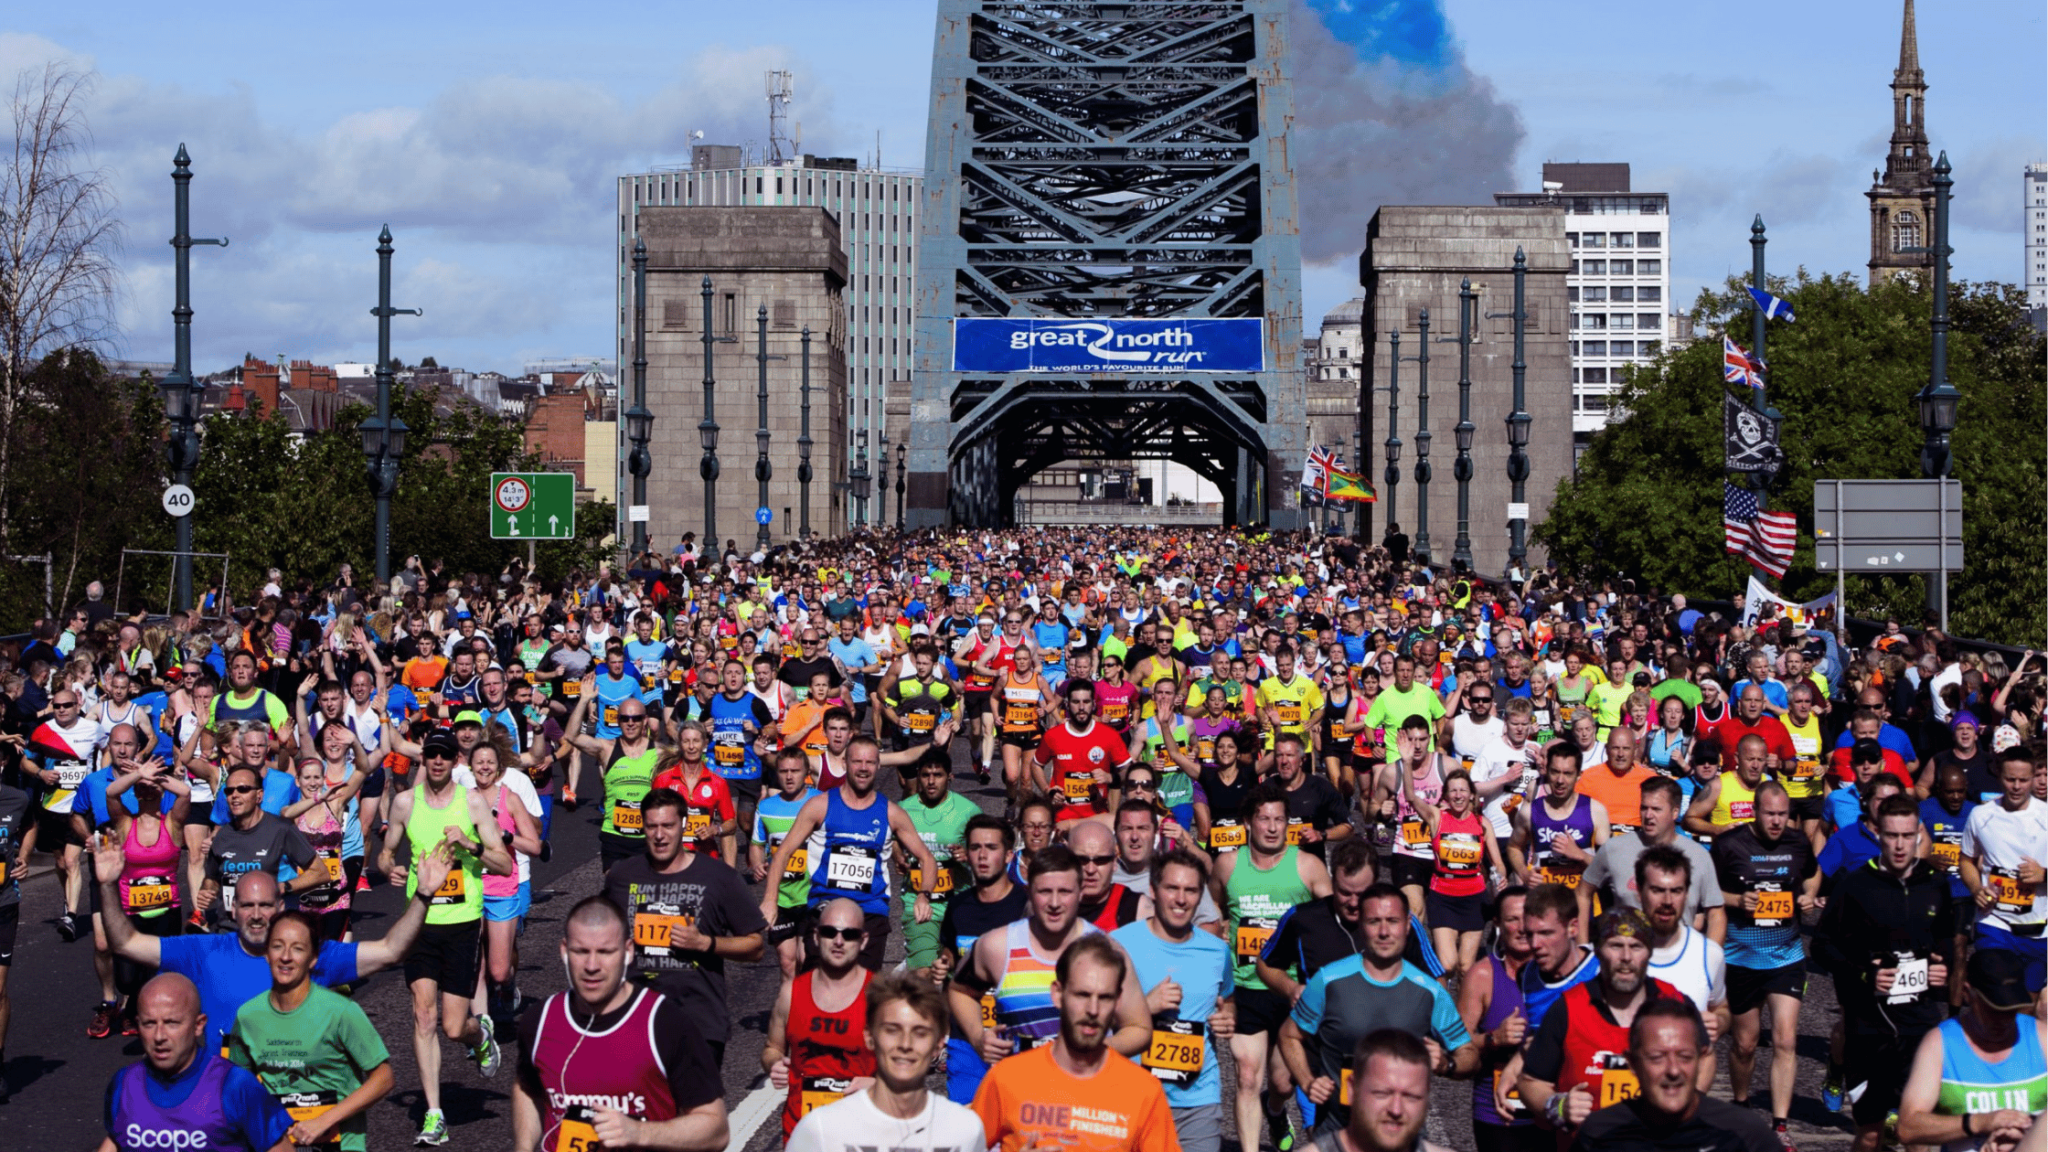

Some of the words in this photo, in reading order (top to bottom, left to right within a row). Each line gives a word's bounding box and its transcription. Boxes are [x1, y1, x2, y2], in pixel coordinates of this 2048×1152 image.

[1010, 330, 1087, 349] great
[1117, 328, 1193, 347] north
[1153, 351, 1202, 363] run
[1102, 364, 1160, 372] FAVOURITE
[502, 486, 516, 494] 4.3
[168, 493, 190, 506] 40
[1066, 784, 1091, 794] 1564
[616, 813, 642, 825] 1288
[1214, 831, 1242, 844] 6589
[1445, 847, 1476, 860] 7663
[832, 862, 872, 878] 17056
[441, 878, 459, 892] 29
[629, 883, 656, 894] RUN
[660, 883, 706, 895] HAPPY
[131, 891, 170, 905] 13749
[660, 893, 704, 906] HAPPY
[1757, 900, 1791, 914] 2475
[638, 924, 669, 940] 117
[1897, 970, 1926, 988] 460
[810, 1016, 849, 1034] STU
[1146, 1043, 1201, 1065] 12788
[546, 1088, 646, 1115] Tommy's
[1966, 1090, 2029, 1114] COLIN
[1021, 1104, 1069, 1128] ONE
[1072, 1107, 1117, 1123] MILLION
[1070, 1119, 1128, 1140] FINISHERS
[127, 1123, 207, 1152] Scope
